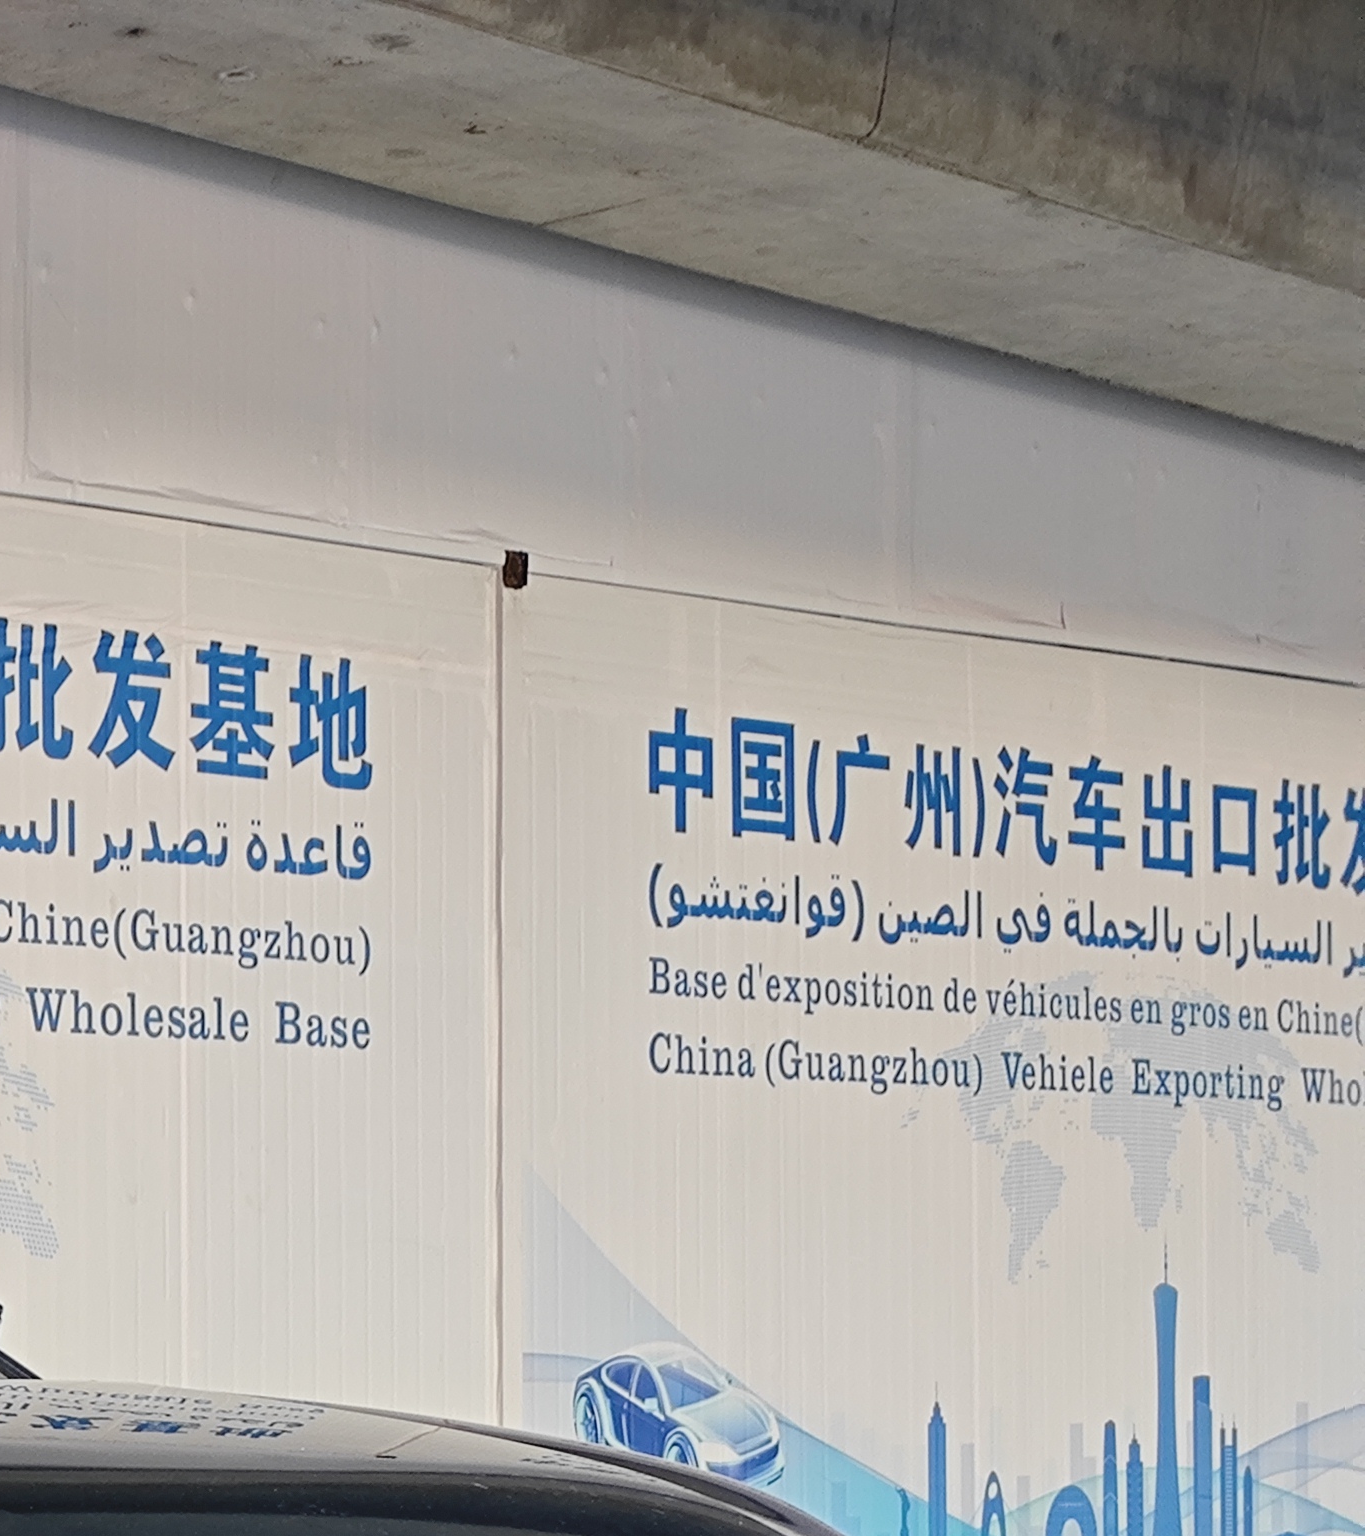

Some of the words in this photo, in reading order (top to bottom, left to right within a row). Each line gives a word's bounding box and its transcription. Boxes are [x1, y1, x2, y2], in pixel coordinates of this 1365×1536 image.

[95, 823, 228, 873] تصدير
[248, 821, 372, 881] قاعدة
[880, 891, 983, 945] الصين
[997, 901, 1053, 955] في
[1064, 901, 1184, 960] بالجملة
[1197, 913, 1332, 970] السيارات
[27, 989, 249, 1042] Wholesale
[277, 1003, 370, 1050] Base
[651, 958, 727, 1000] Base
[739, 965, 934, 1015] d'exposition
[945, 979, 977, 1015] de
[988, 980, 1122, 1023] véhicules
[1132, 1000, 1163, 1025] en
[1172, 1002, 1231, 1037] gros
[1240, 1007, 1269, 1032] en
[651, 1034, 756, 1078] China
[765, 1040, 984, 1094] (Guangzhou)
[1133, 1060, 1285, 1112] Exporting
[1301, 1068, 1365, 1107] Who
